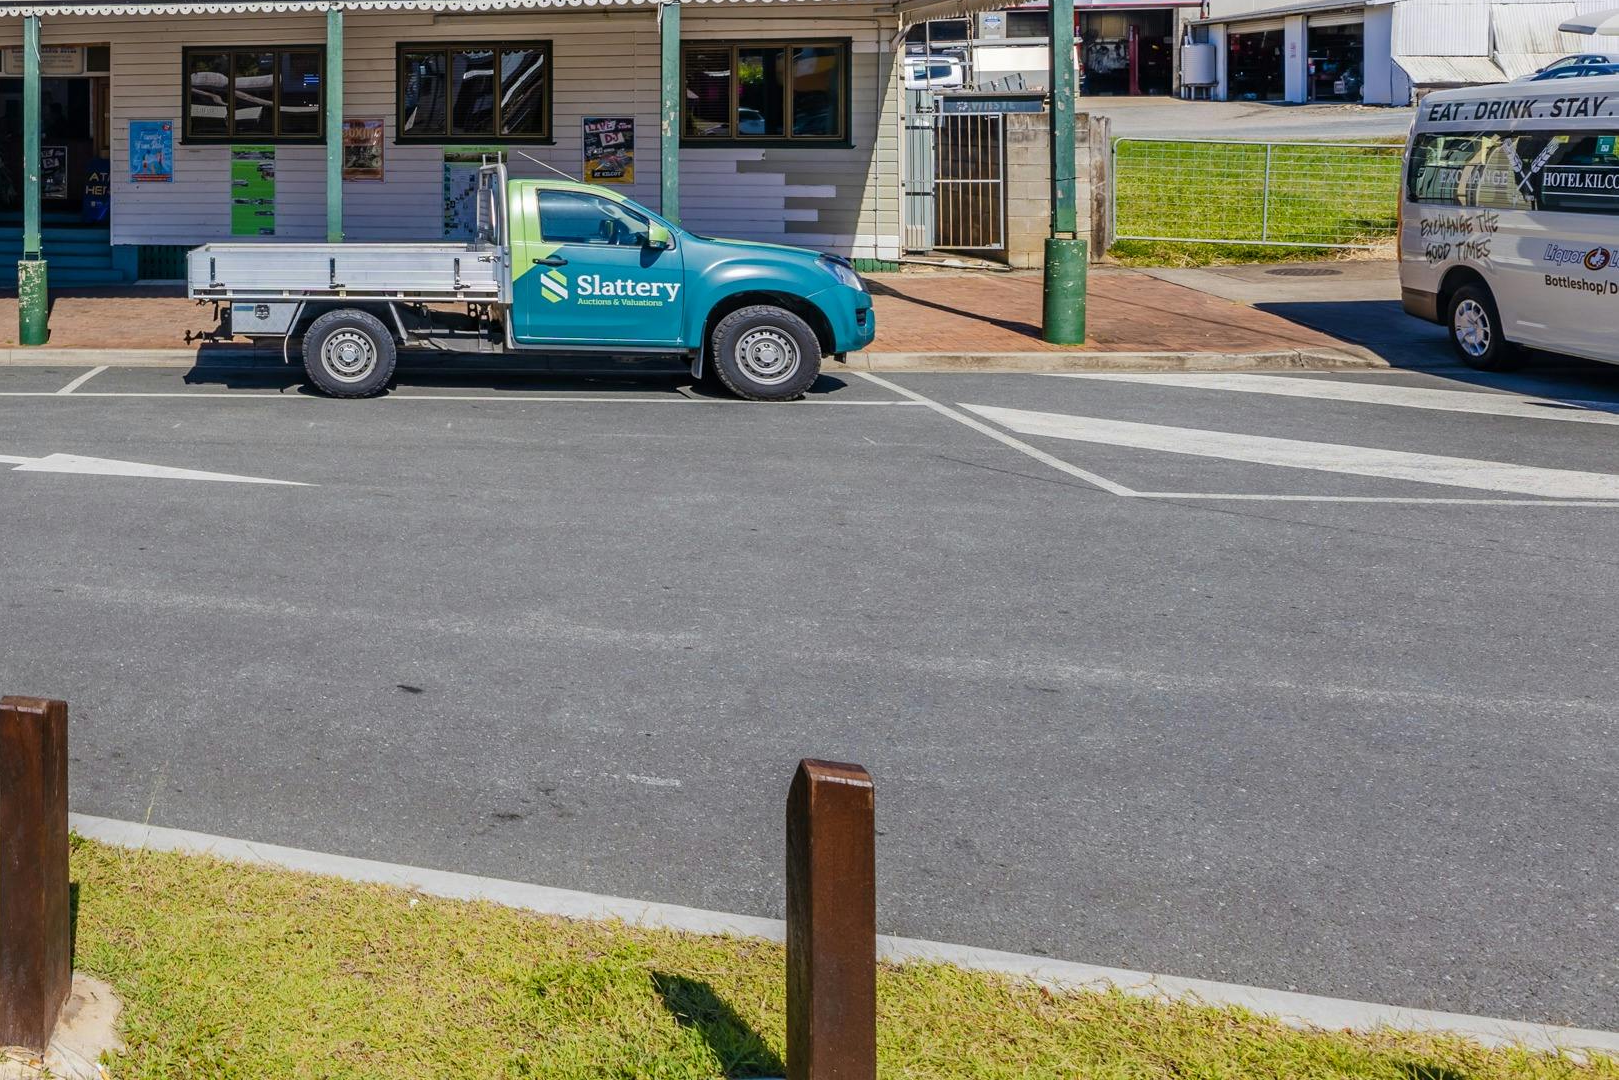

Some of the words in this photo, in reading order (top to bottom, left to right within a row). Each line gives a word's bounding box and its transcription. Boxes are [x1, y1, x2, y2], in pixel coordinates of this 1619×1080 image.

[88, 171, 110, 182] AT
[1543, 172, 1584, 188] HOTEL
[1420, 214, 1473, 240] EXCHANGE
[1476, 209, 1500, 236] THE
[1425, 242, 1451, 263] GOOD
[1456, 238, 1492, 261] TIMES
[1543, 243, 1587, 267] Liquor
[576, 274, 681, 302] Slattery
[577, 297, 612, 306] Auctions
[612, 298, 620, 306] &
[620, 298, 664, 307] Valuations
